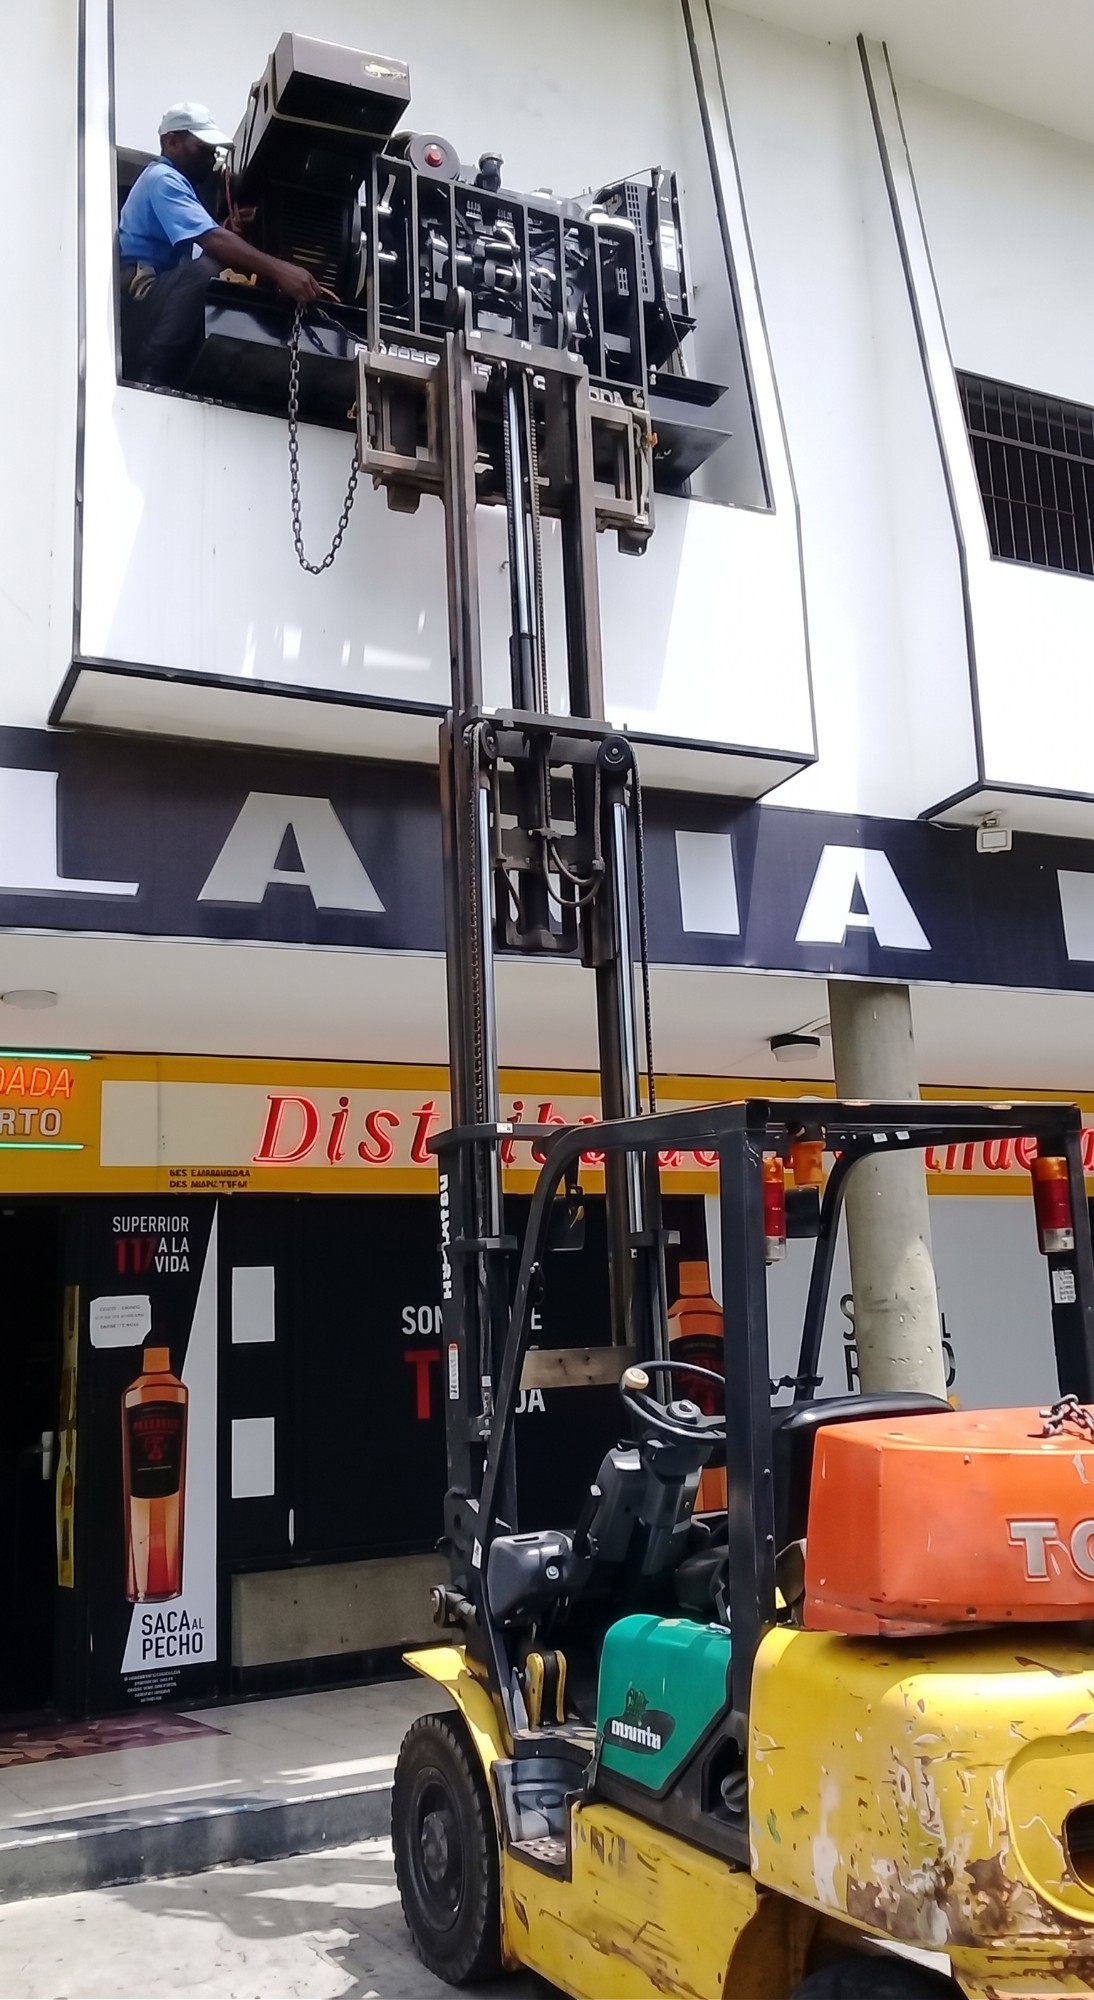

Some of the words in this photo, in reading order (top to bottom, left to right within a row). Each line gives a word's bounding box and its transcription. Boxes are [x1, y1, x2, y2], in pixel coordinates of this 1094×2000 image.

[112, 1216, 189, 1233] SUPERRIOR
[158, 1237, 168, 1253] A
[172, 1236, 190, 1253] LA
[155, 1255, 190, 1273] VIDA
[141, 1610, 190, 1635] SACA
[191, 1617, 205, 1630] AL
[142, 1632, 203, 1660] PECHO
